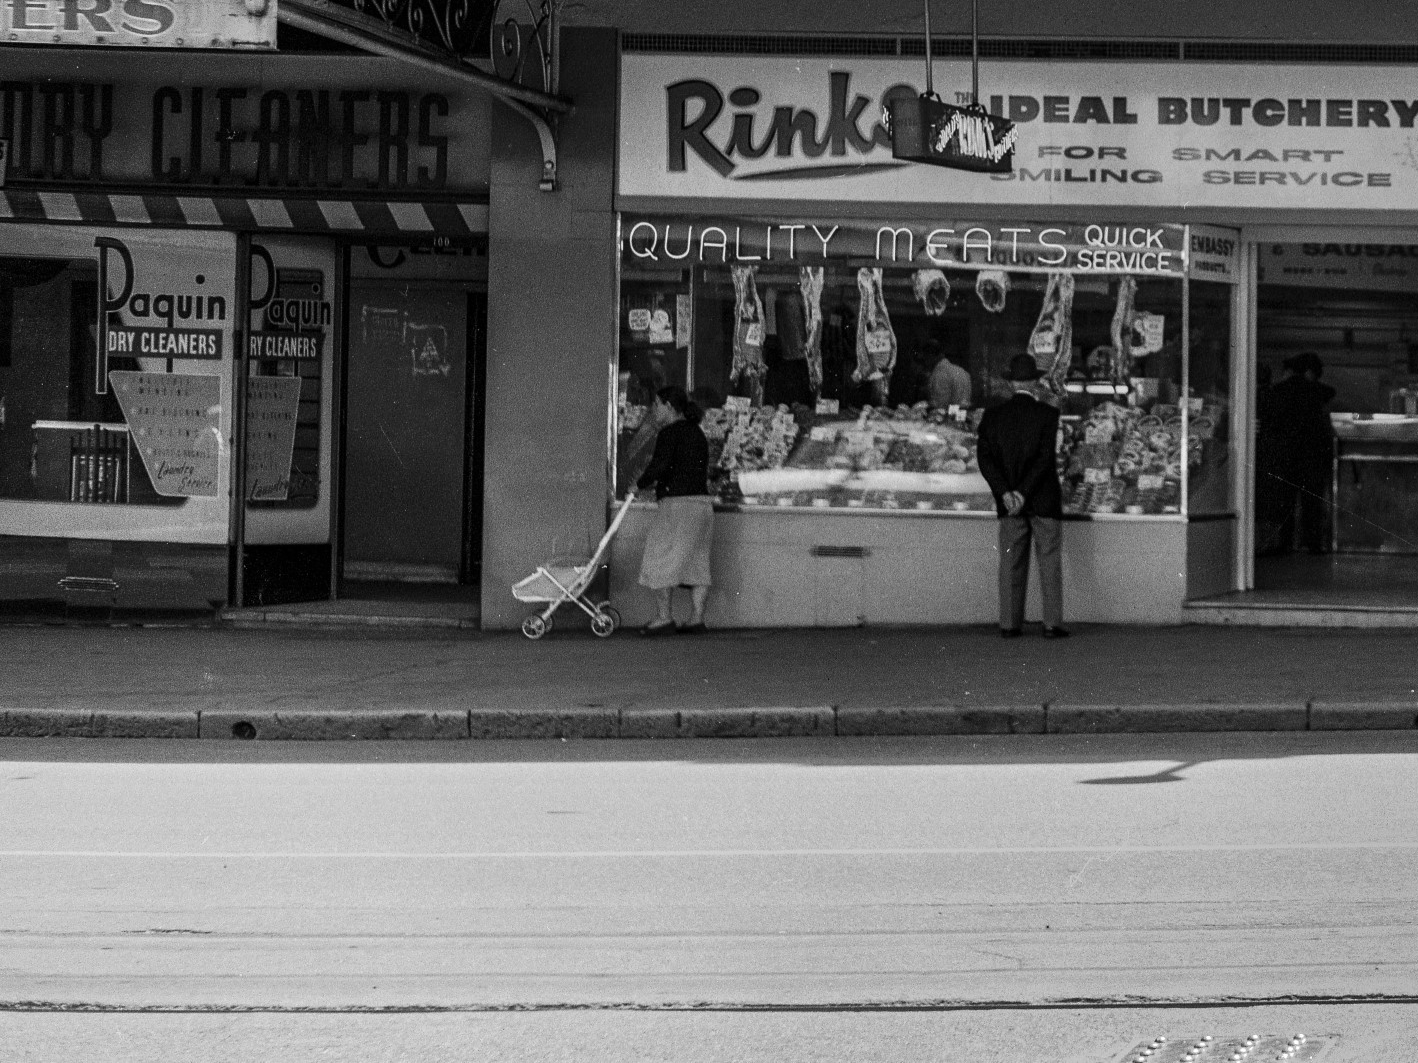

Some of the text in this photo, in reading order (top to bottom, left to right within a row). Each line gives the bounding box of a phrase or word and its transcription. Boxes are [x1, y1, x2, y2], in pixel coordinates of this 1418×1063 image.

[990, 94, 1138, 125] IDEAL
[1, 81, 450, 190] DRY CLEANERS
[1038, 145, 1345, 163] FOR SMART
[1202, 170, 1392, 187] SERVICE
[433, 236, 451, 246] 100
[629, 222, 839, 262] QUALITY
[876, 226, 1067, 265] MEATS
[1084, 224, 1164, 251] QUICK
[1076, 249, 1172, 274] SERVICE
[94, 236, 227, 394] Paquin
[108, 330, 217, 355] DRY CLEANERS
[250, 335, 317, 358] RY CLEANERS
